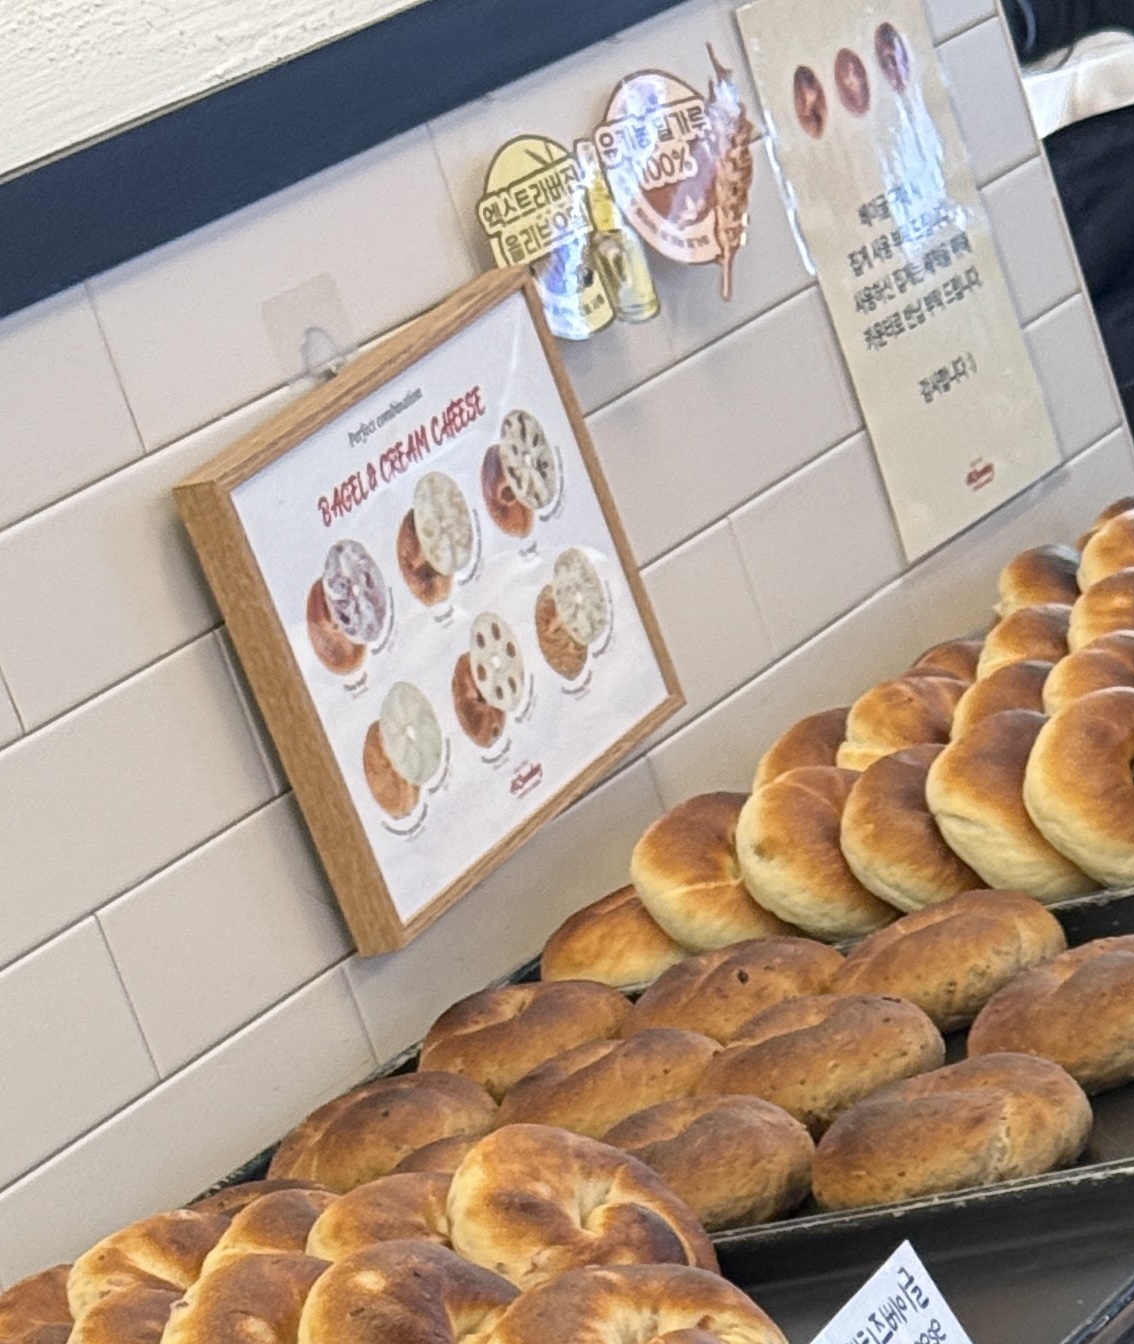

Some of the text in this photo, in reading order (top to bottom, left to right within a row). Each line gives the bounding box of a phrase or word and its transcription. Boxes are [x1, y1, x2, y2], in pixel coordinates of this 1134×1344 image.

[599, 106, 706, 158] 유기농 밀가루
[636, 146, 693, 184] 100%
[317, 471, 369, 527] BAGEL
[379, 424, 431, 483] CREAM
[431, 385, 486, 446] CHEESE
